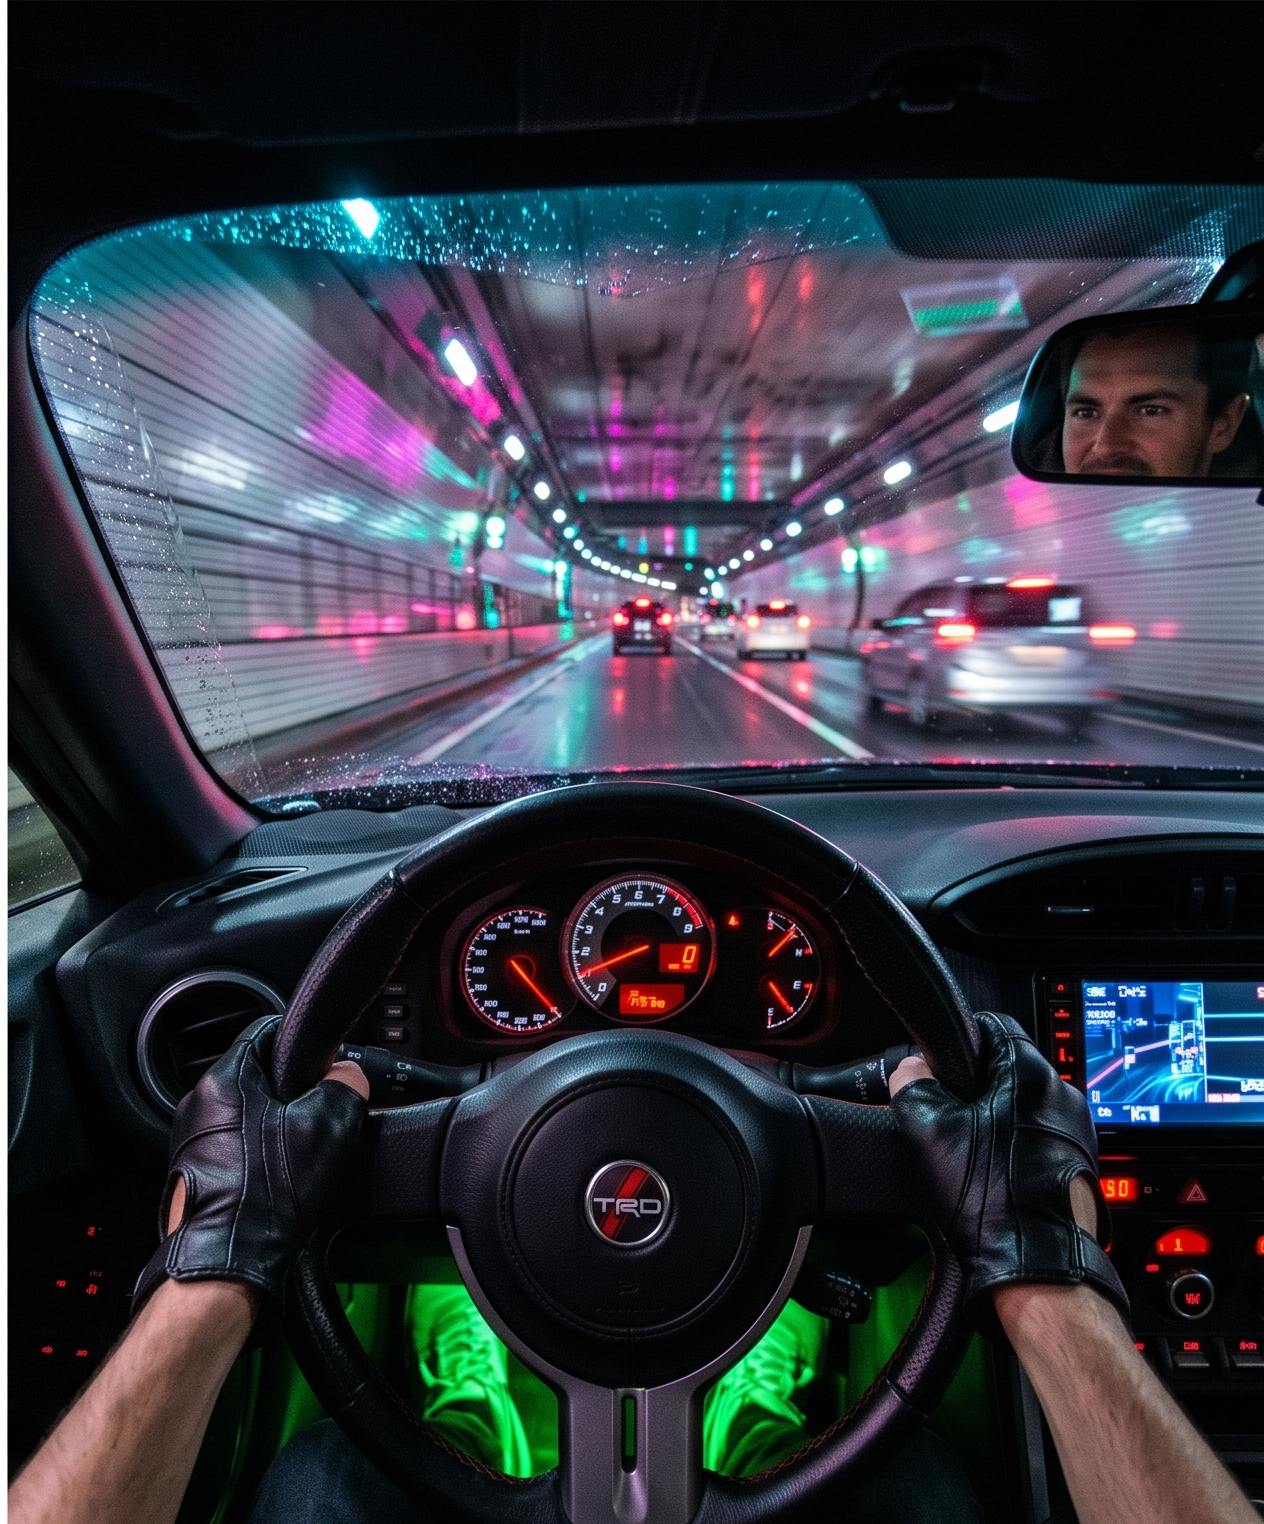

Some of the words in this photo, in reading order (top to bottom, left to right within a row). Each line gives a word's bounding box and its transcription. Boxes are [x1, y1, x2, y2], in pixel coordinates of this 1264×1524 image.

[612, 894, 621, 903] 5
[634, 890, 644, 900] 6
[656, 895, 666, 904] 7
[595, 906, 605, 916] 4
[584, 925, 594, 934] 3
[580, 946, 591, 956] 2
[682, 945, 697, 963] 0
[598, 982, 608, 992] 0
[793, 980, 802, 990] E
[593, 1197, 662, 1218] TRD
